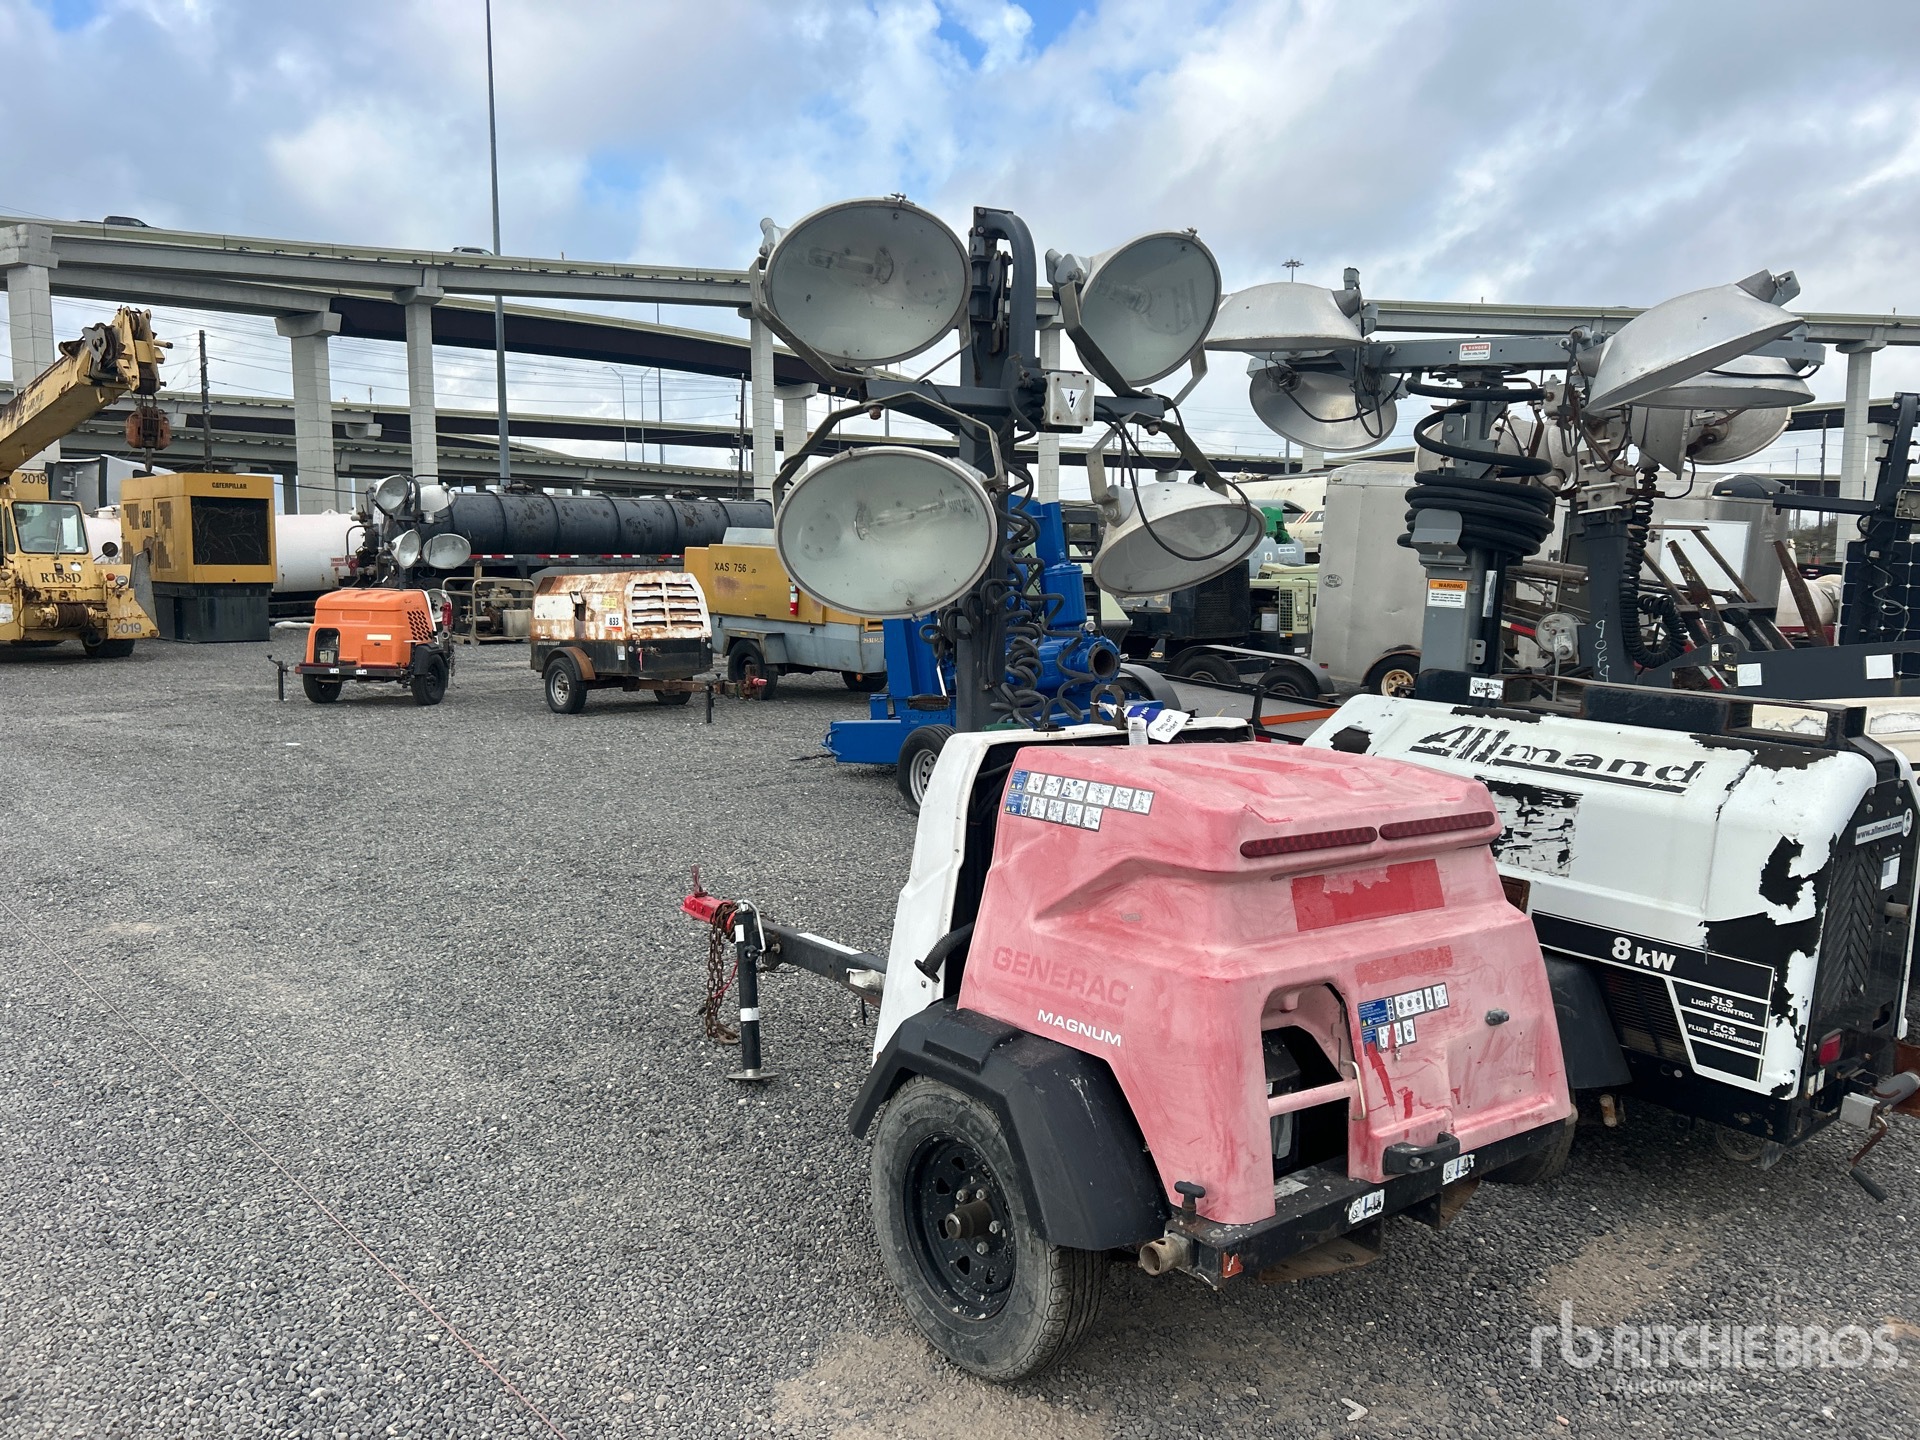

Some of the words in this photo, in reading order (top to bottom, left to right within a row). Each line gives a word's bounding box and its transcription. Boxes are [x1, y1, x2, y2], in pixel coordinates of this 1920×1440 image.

[21, 473, 47, 484] 2019
[211, 482, 248, 490] CATERPILLAR
[141, 510, 152, 529] CAT
[714, 562, 730, 572] XAS
[733, 563, 747, 573] 756
[40, 572, 82, 584] RT58D
[113, 622, 142, 634] 2019
[1165, 720, 1179, 733] Order
[1412, 724, 1707, 785] Allmand
[1856, 821, 1903, 840] www.allmand.com
[1611, 936, 1632, 960] 8
[1634, 946, 1676, 972] kW
[992, 945, 1129, 1008] GENERAC
[1690, 998, 1715, 1009] LIGHT
[1716, 1005, 1756, 1020] CONTROL
[1710, 995, 1734, 1008] SLS
[1037, 1009, 1122, 1047] MAGNUM
[1687, 1023, 1708, 1034] FLUID
[1709, 1029, 1761, 1048] CONTAINMENT
[1713, 1022, 1736, 1036] FCS
